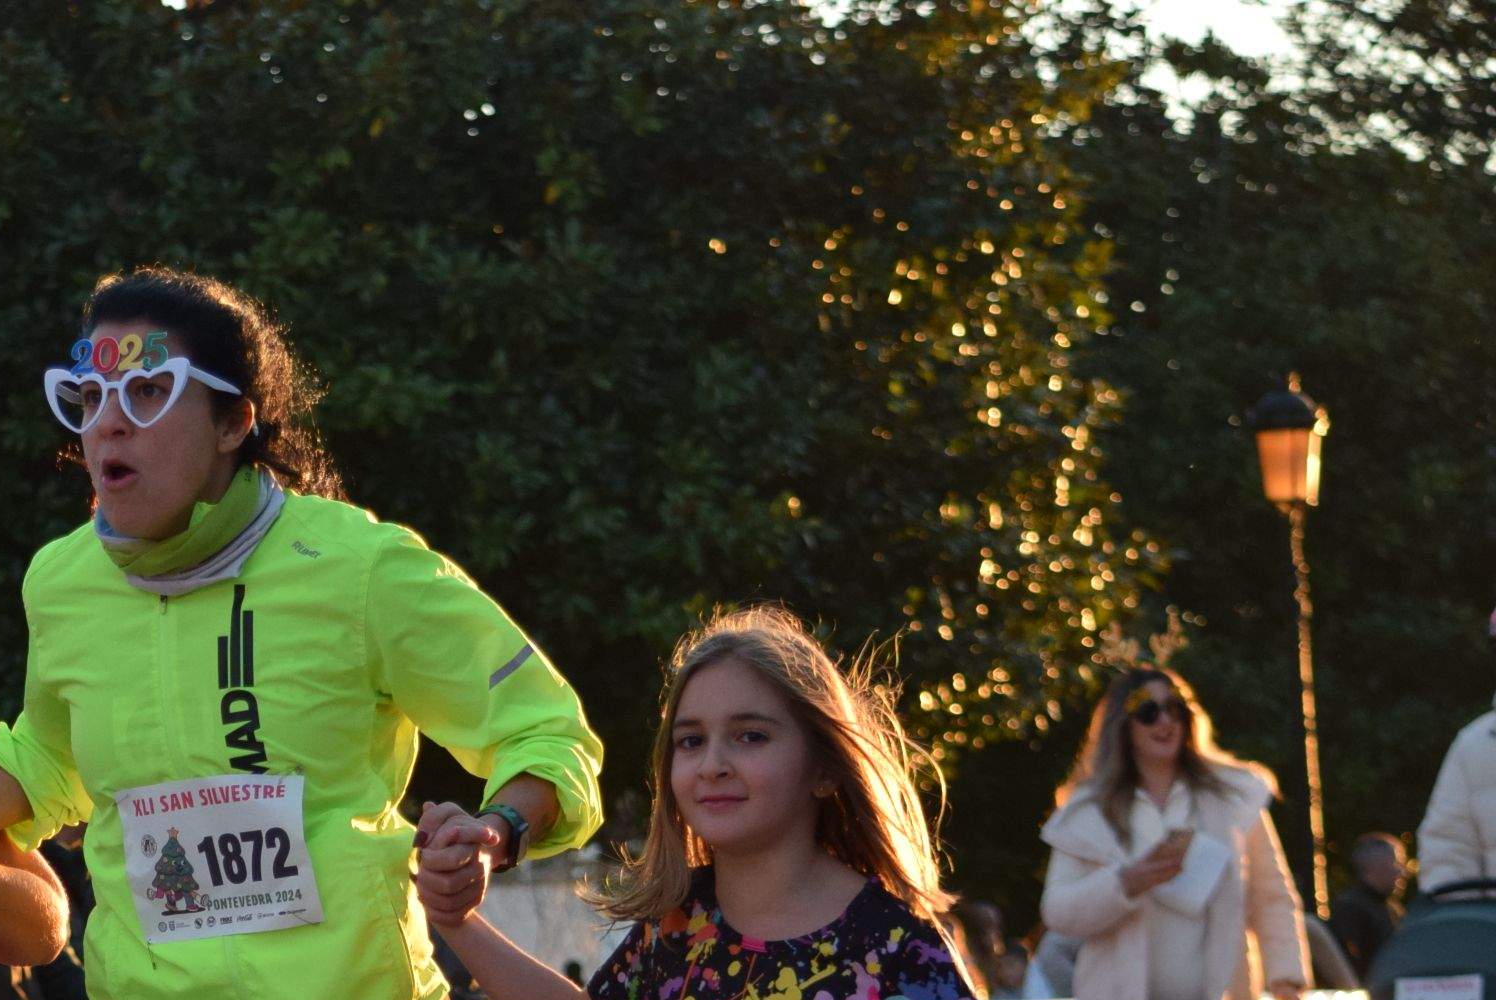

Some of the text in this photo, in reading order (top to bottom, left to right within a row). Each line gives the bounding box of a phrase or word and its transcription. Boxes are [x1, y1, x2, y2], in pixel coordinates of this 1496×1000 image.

[70, 330, 169, 376] 2025
[132, 783, 286, 817] XLI SAN SILVESTRE
[197, 827, 299, 887] 1872
[205, 892, 273, 912] PONTEVEDRA
[275, 888, 303, 904] 2024
